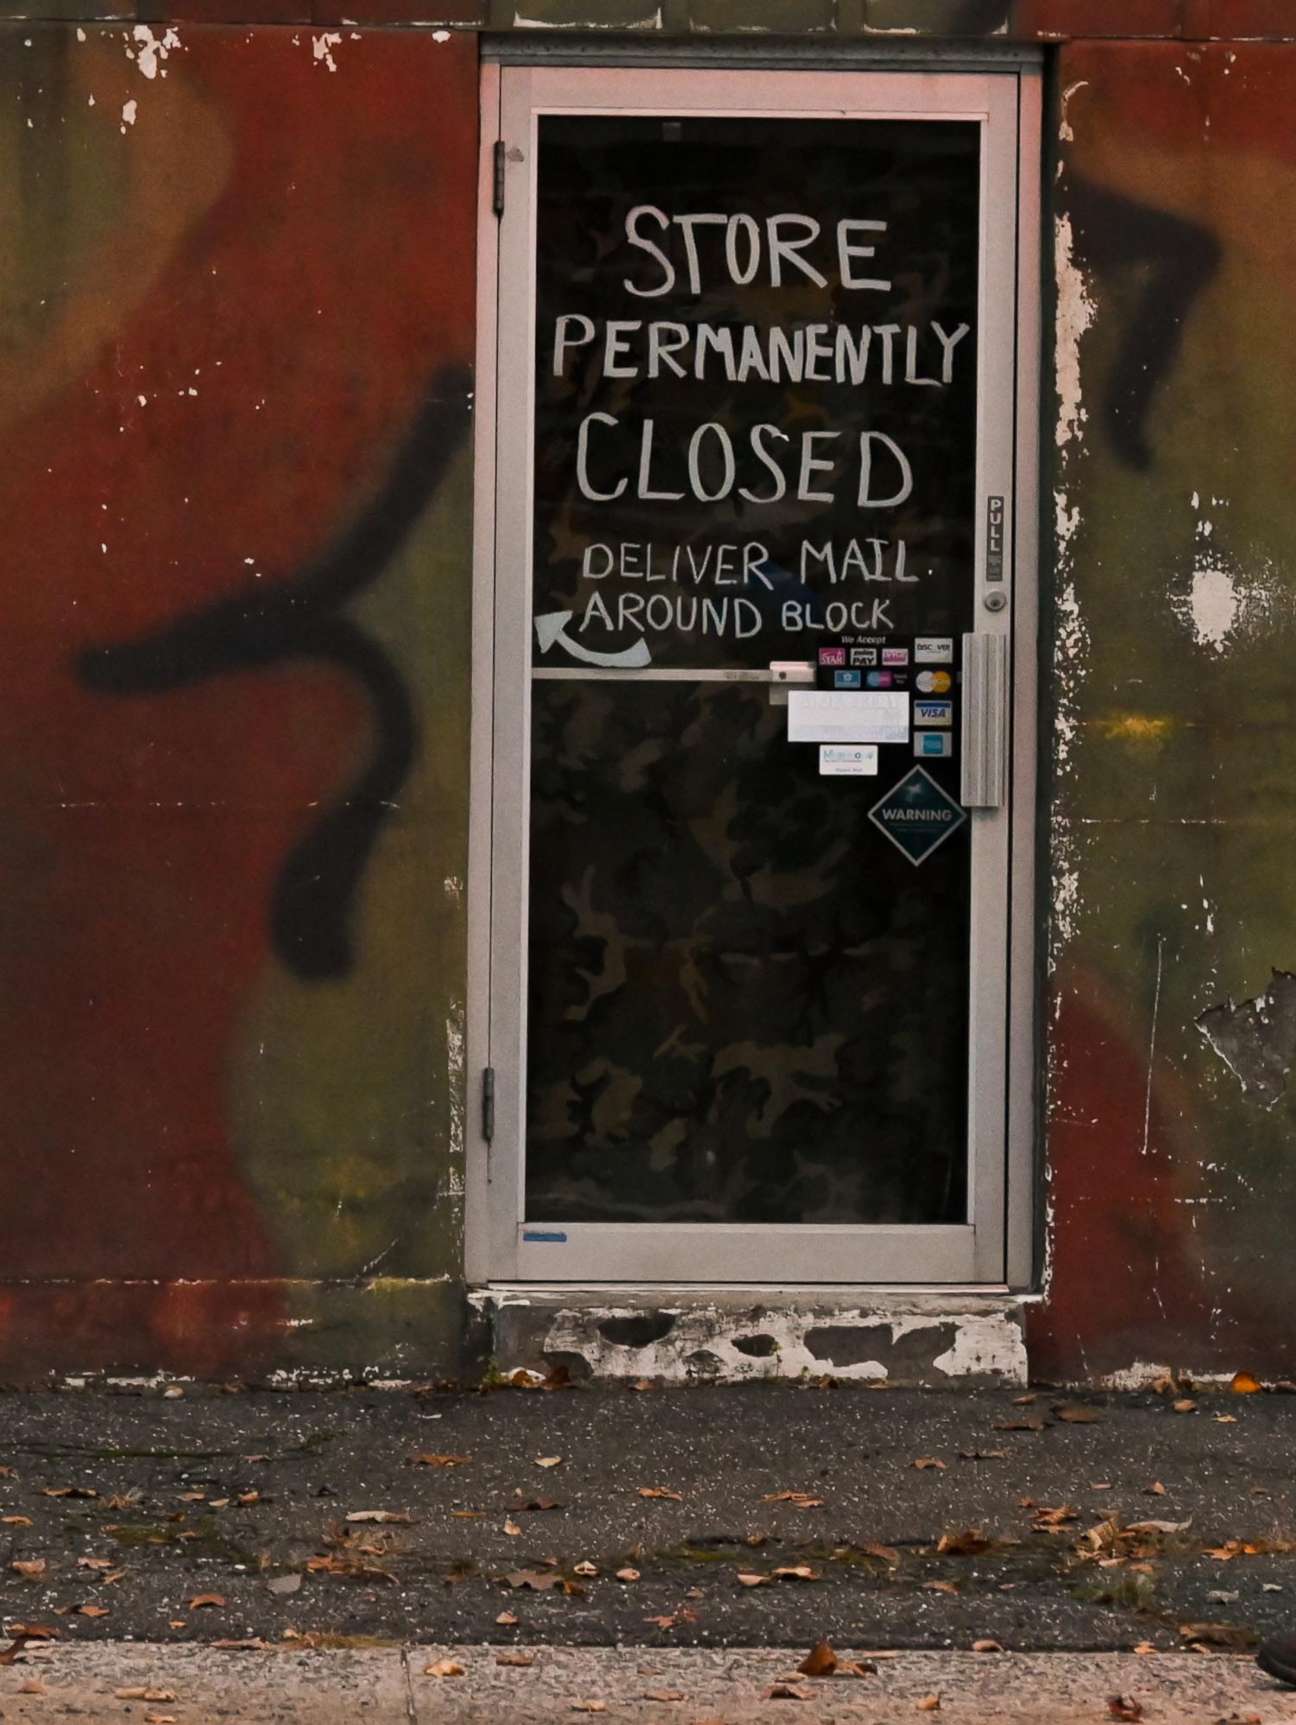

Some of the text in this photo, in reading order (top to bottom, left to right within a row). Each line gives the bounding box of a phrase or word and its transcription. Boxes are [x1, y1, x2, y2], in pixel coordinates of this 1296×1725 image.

[623, 205, 892, 297] STORE
[553, 314, 970, 387] PERMANENTLY
[576, 412, 914, 508] CLOSED
[988, 498, 1002, 552] PULL
[582, 537, 920, 590] DELIVER MAIL
[578, 592, 895, 639] AROUND BLOCK
[920, 708, 946, 718] VISA
[882, 808, 952, 821] WARNING
